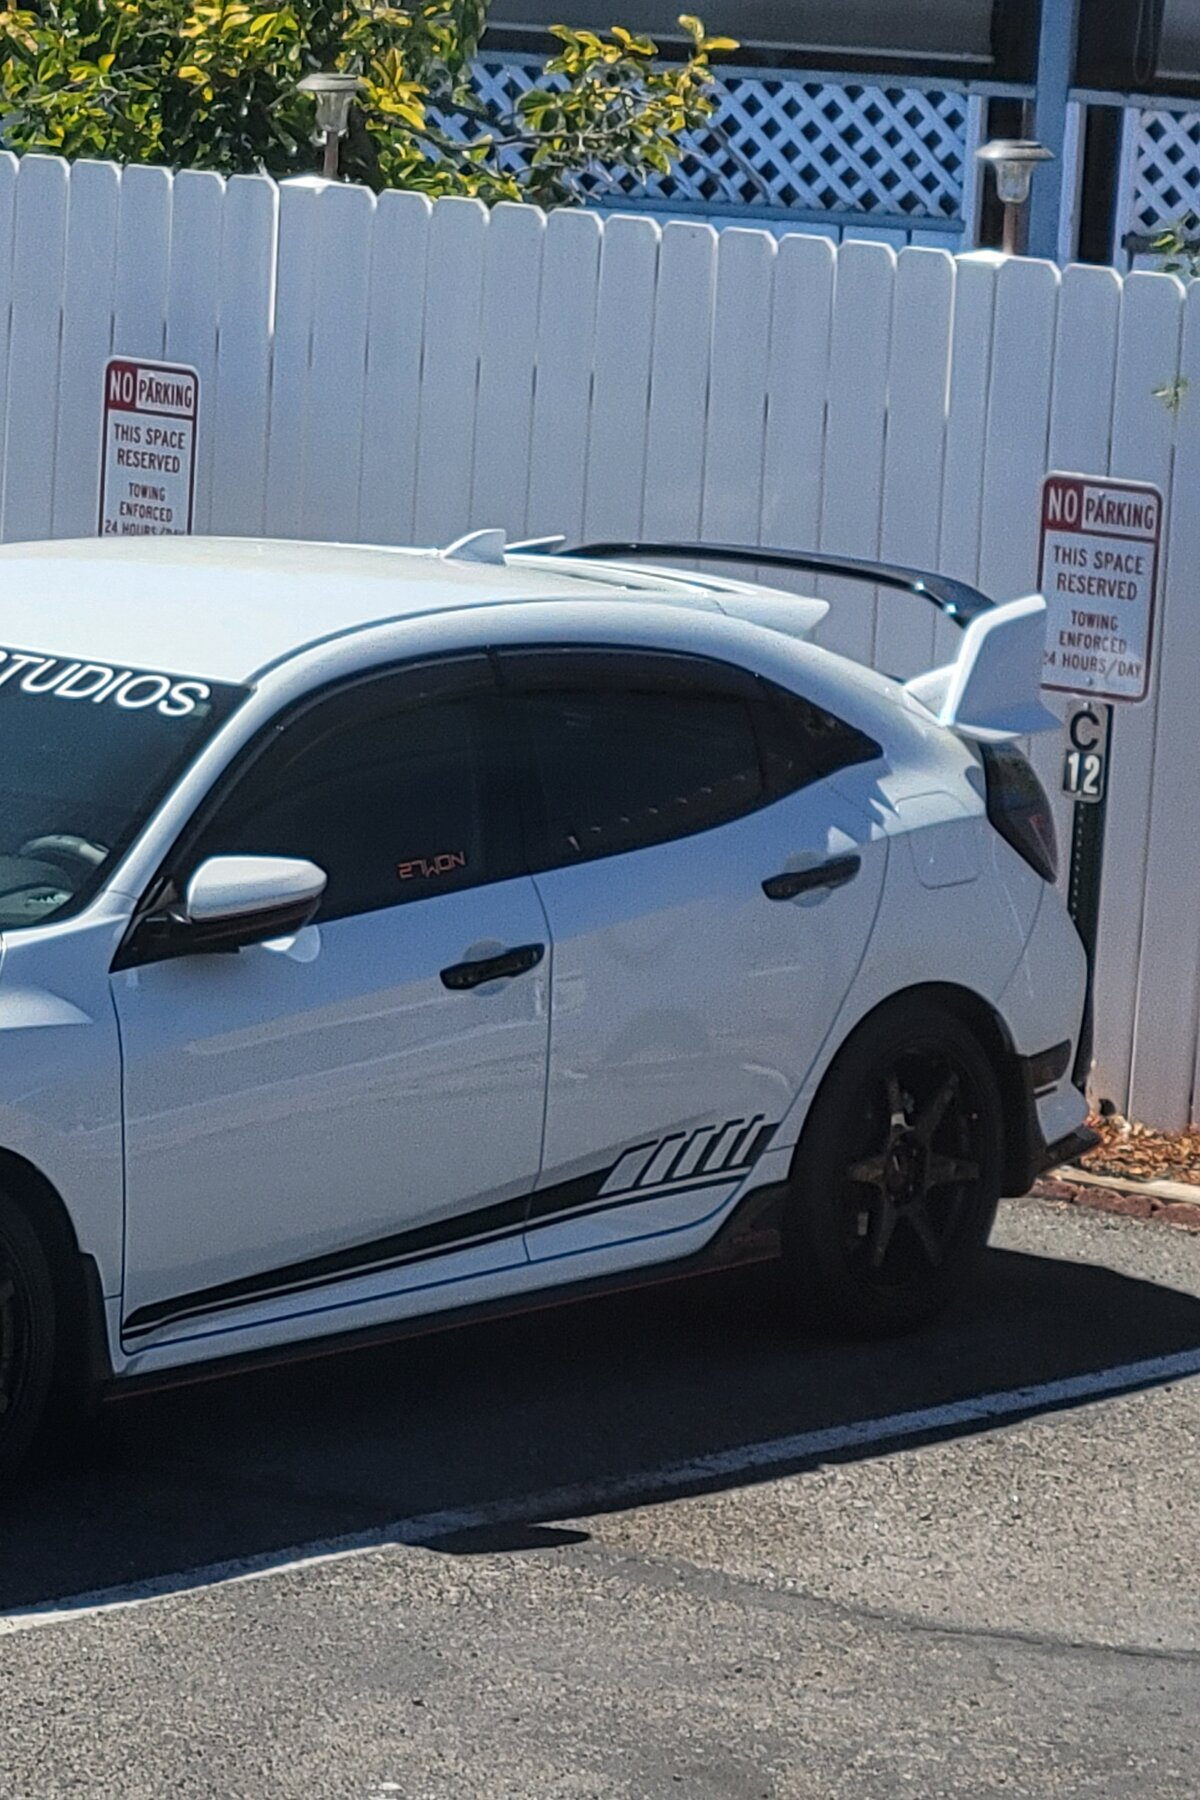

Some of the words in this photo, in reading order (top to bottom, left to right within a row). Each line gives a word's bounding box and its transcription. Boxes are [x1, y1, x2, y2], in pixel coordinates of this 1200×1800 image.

[110, 370, 134, 403] NO
[138, 377, 192, 409] PARKING
[114, 423, 141, 444] THIS
[145, 428, 186, 450] SPACE
[117, 447, 181, 473] RESERVED
[128, 482, 166, 502] TOWING
[119, 501, 173, 523] ENFORCED
[1048, 486, 1079, 523] NO
[1086, 497, 1154, 530] PARKING
[104, 519, 118, 534] 24
[1054, 545, 1088, 567] THIS
[1093, 551, 1145, 575] SPACE
[1057, 572, 1138, 601] RESERVED
[1071, 609, 1119, 631] TOWING
[1059, 630, 1127, 655] ENFORCED
[1062, 652, 1143, 680] HOURS/DAY
[1070, 711, 1099, 750] C
[1067, 752, 1100, 795] 12
